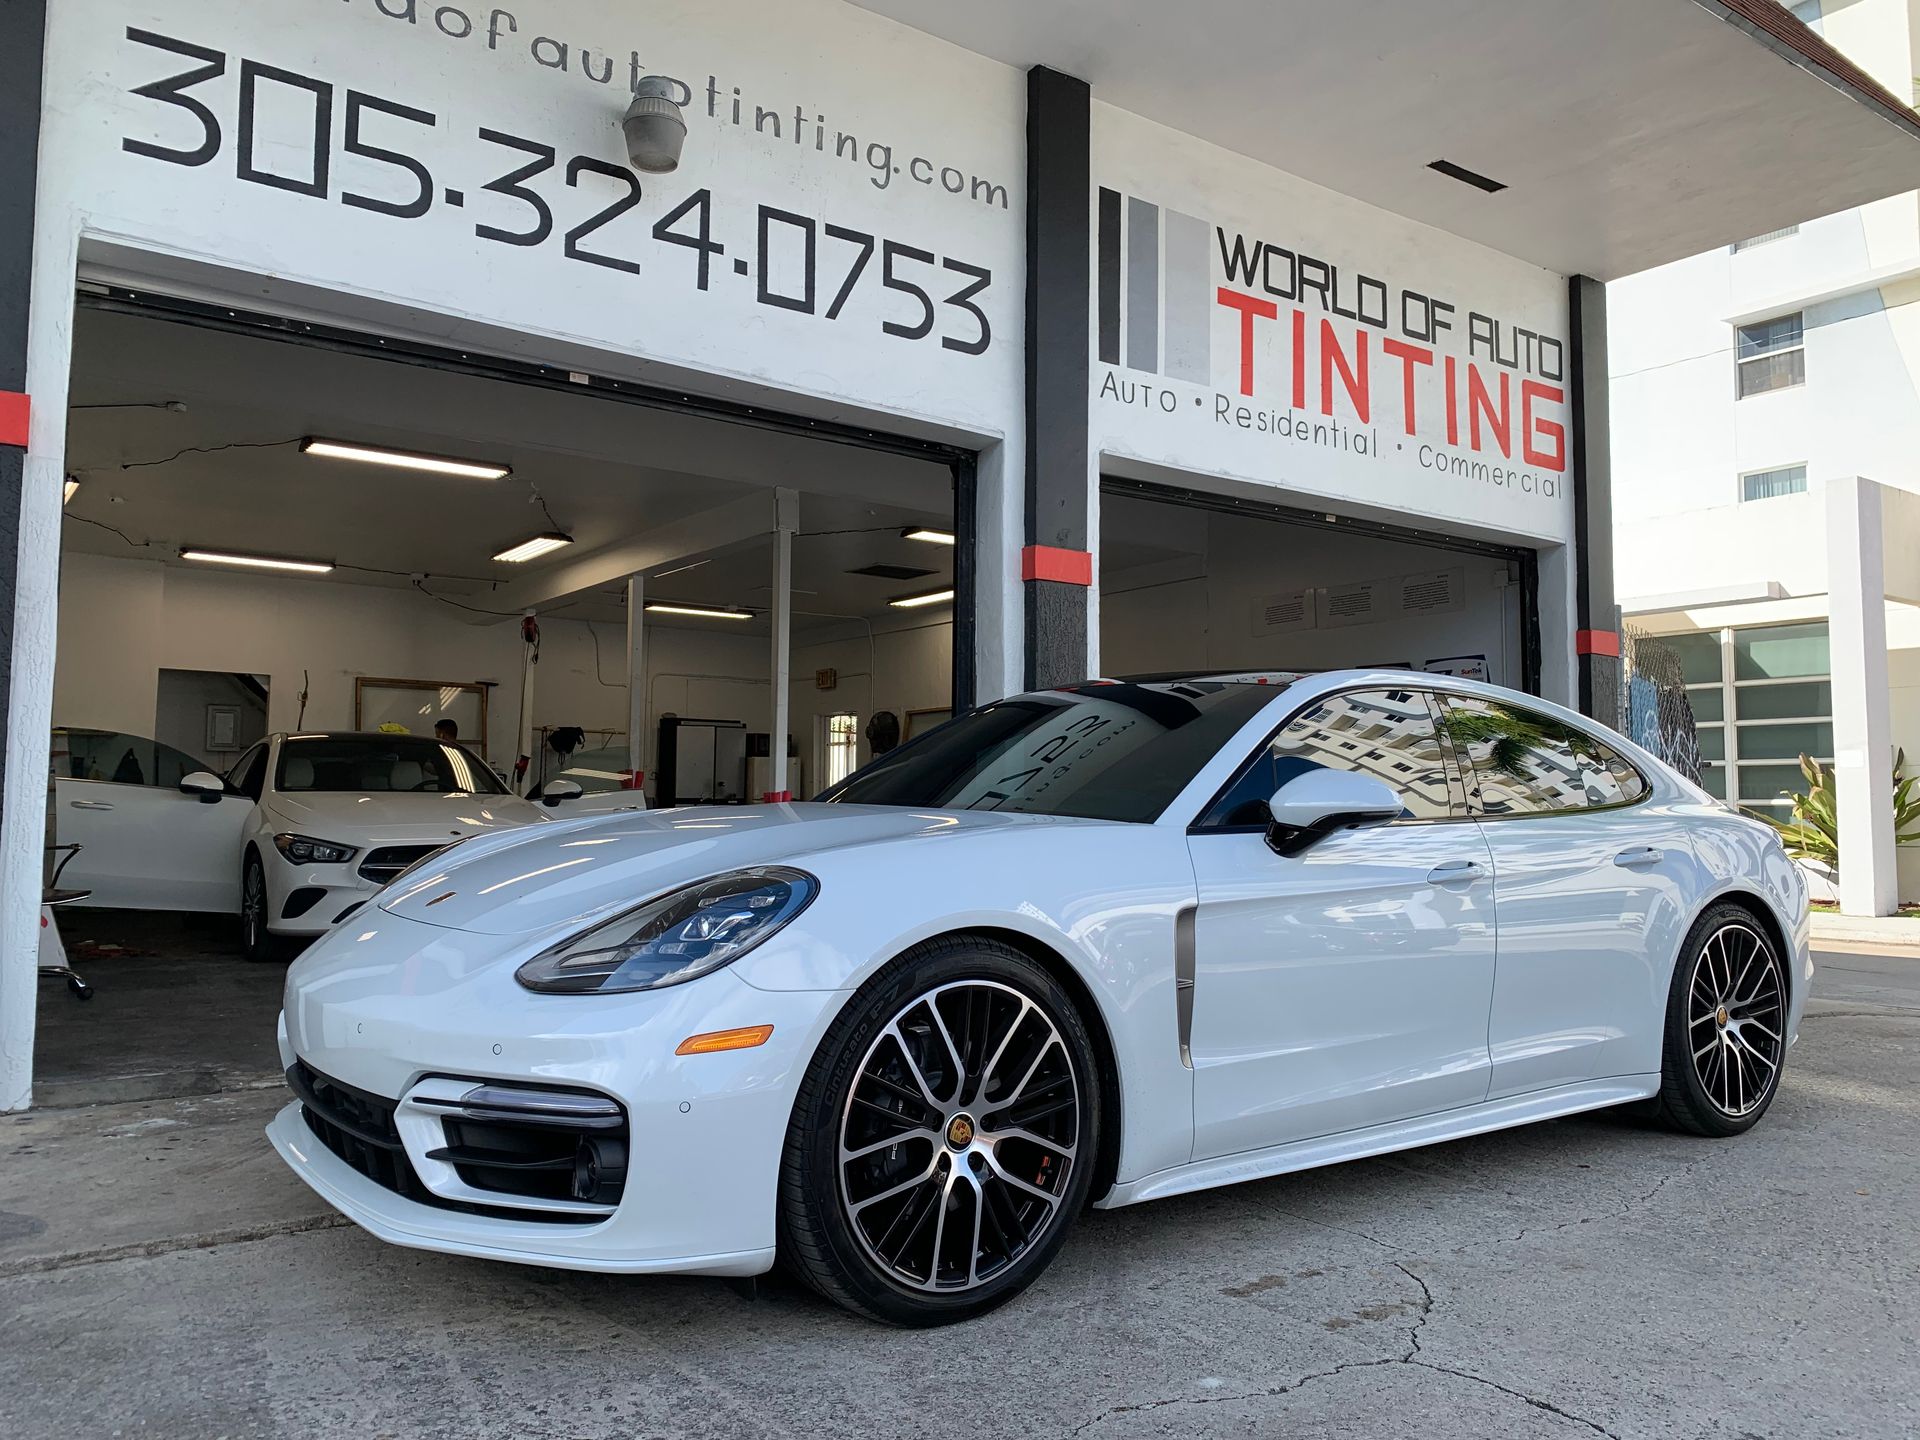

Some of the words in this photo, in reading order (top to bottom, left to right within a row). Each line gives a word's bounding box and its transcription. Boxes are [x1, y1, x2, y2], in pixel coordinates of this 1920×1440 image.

[121, 26, 992, 356] 305.324.0753
[1216, 226, 1388, 330] WORLD
[1401, 289, 1455, 344] OF
[1468, 310, 1563, 383] AUTO
[1217, 286, 1566, 473] TINTING
[1215, 392, 1378, 459] Residential
[1418, 444, 1563, 500] Commercial
